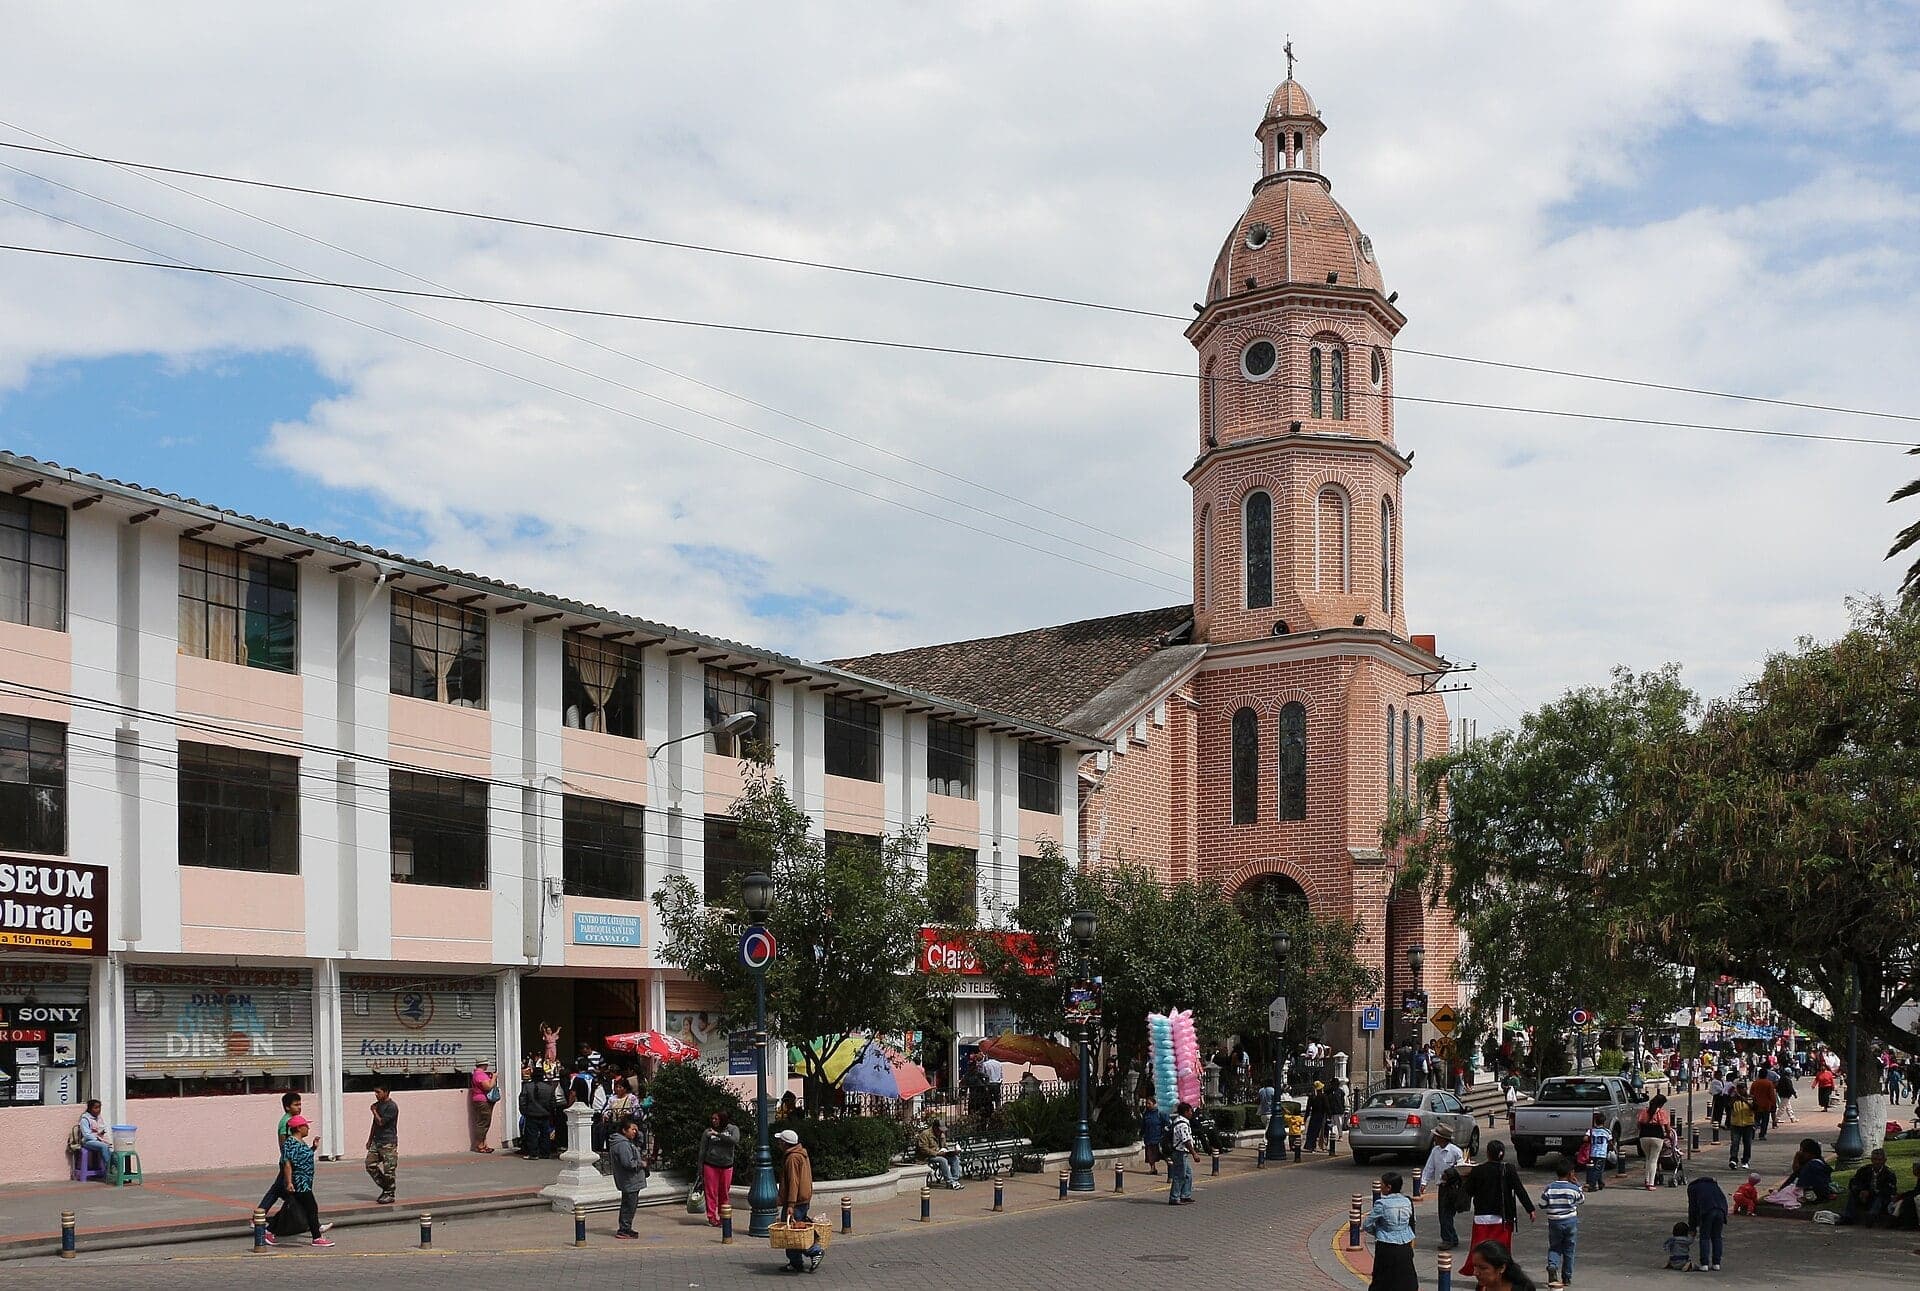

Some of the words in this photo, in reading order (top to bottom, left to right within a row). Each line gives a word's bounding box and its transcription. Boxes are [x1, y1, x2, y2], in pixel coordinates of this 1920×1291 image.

[0, 900, 93, 934] braje
[578, 915, 599, 924] CENTRO
[599, 916, 607, 924] DE
[607, 917, 637, 926] CATEQUESIS
[580, 924, 611, 934] PARROQUIA
[13, 935, 31, 944] 150
[35, 937, 72, 947] metros
[585, 934, 629, 942] OTAVALO
[927, 944, 976, 970] Claro
[19, 1007, 81, 1022] SONY
[360, 1038, 463, 1056] Kelvinator
[366, 1058, 408, 1068] CALIDAD
[416, 1057, 458, 1068] CLASICA
